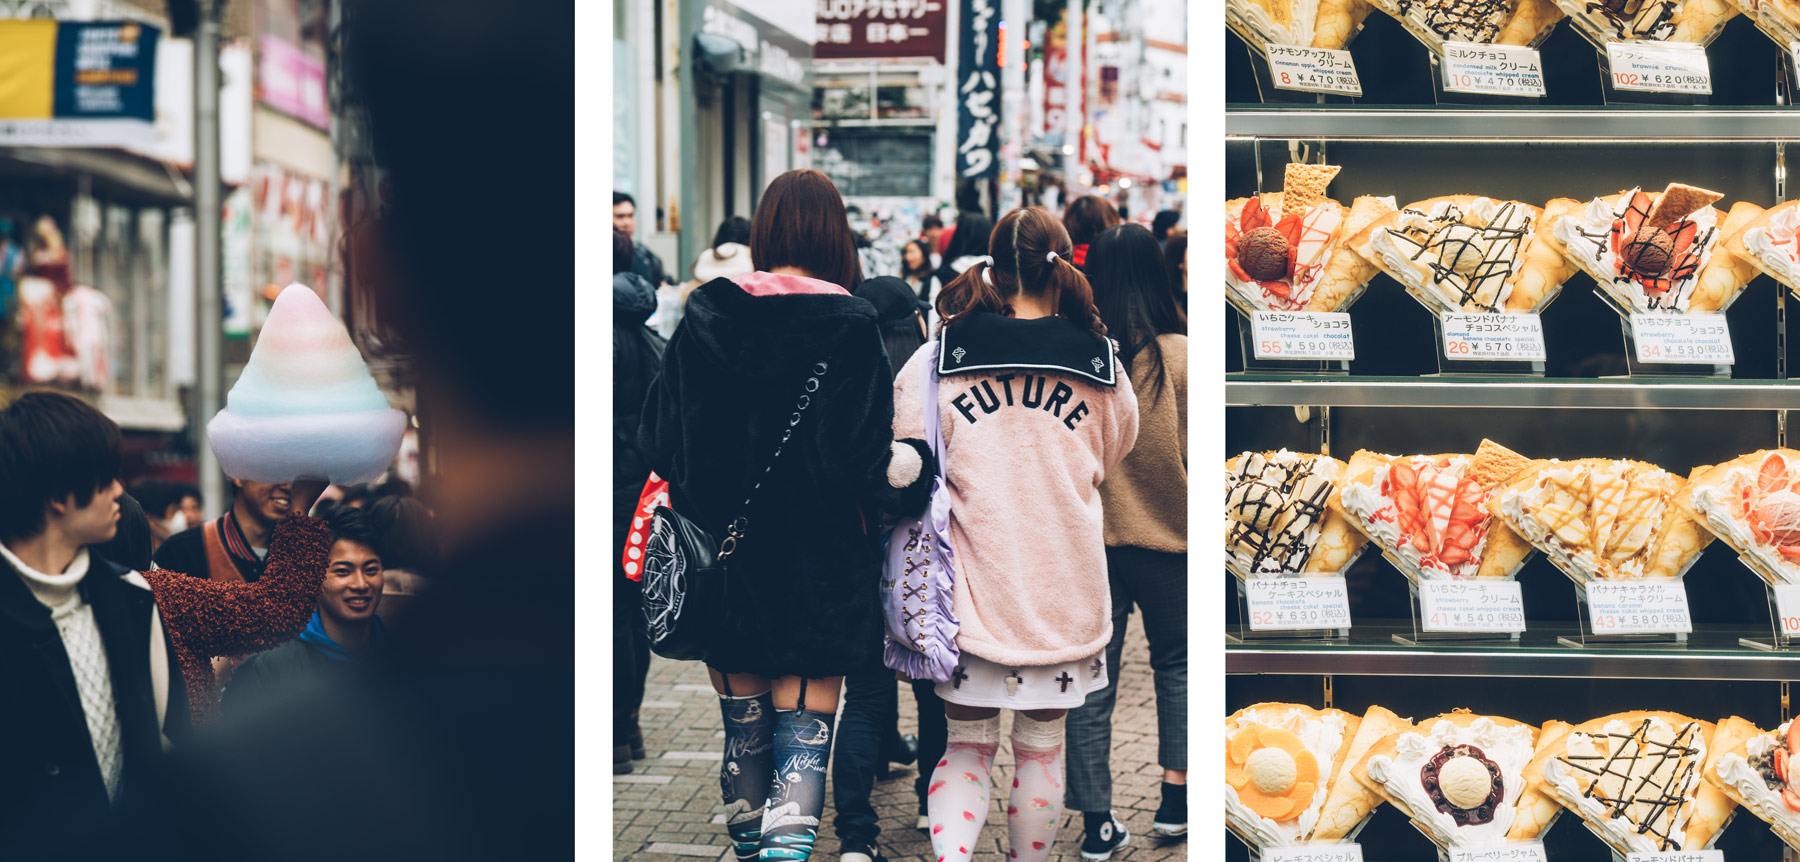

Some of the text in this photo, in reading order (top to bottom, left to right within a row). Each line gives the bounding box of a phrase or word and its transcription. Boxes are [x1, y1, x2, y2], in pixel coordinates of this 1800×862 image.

[1270, 47, 1335, 59] シナモンアップル
[1450, 49, 1507, 60] ミルクチョコ
[1318, 60, 1352, 69] クリーム
[1500, 62, 1538, 72] クリーム
[1281, 72, 1291, 84] 8
[1453, 74, 1471, 87] 10
[1614, 73, 1639, 85] 102
[1260, 314, 1314, 322] いちごケーキ
[1445, 315, 1518, 324] アーモンドバナナ
[1638, 318, 1691, 326] いちごチョコ
[1314, 321, 1350, 329] ショコラ
[1466, 324, 1539, 333] チョコスペシャル
[1690, 326, 1725, 335] ショコラ
[1262, 341, 1282, 354] 55
[1449, 342, 1469, 354] 26
[1641, 345, 1661, 358] 34
[952, 373, 1089, 431] FUTURE
[1252, 581, 1307, 590] バナナチョコ
[1430, 585, 1487, 593] いちごケーキ
[1592, 585, 1665, 594] バナナキャラメル
[1268, 590, 1343, 599] ケーキスペシャル
[1481, 595, 1520, 604] クリーム
[1619, 595, 1683, 603] ケーキクリーム
[1253, 612, 1273, 625] 52
[1430, 613, 1448, 626] 41
[1595, 615, 1616, 628] 43
[781, 752, 821, 775] Night
[1457, 849, 1538, 862] ブルーベリージャム
